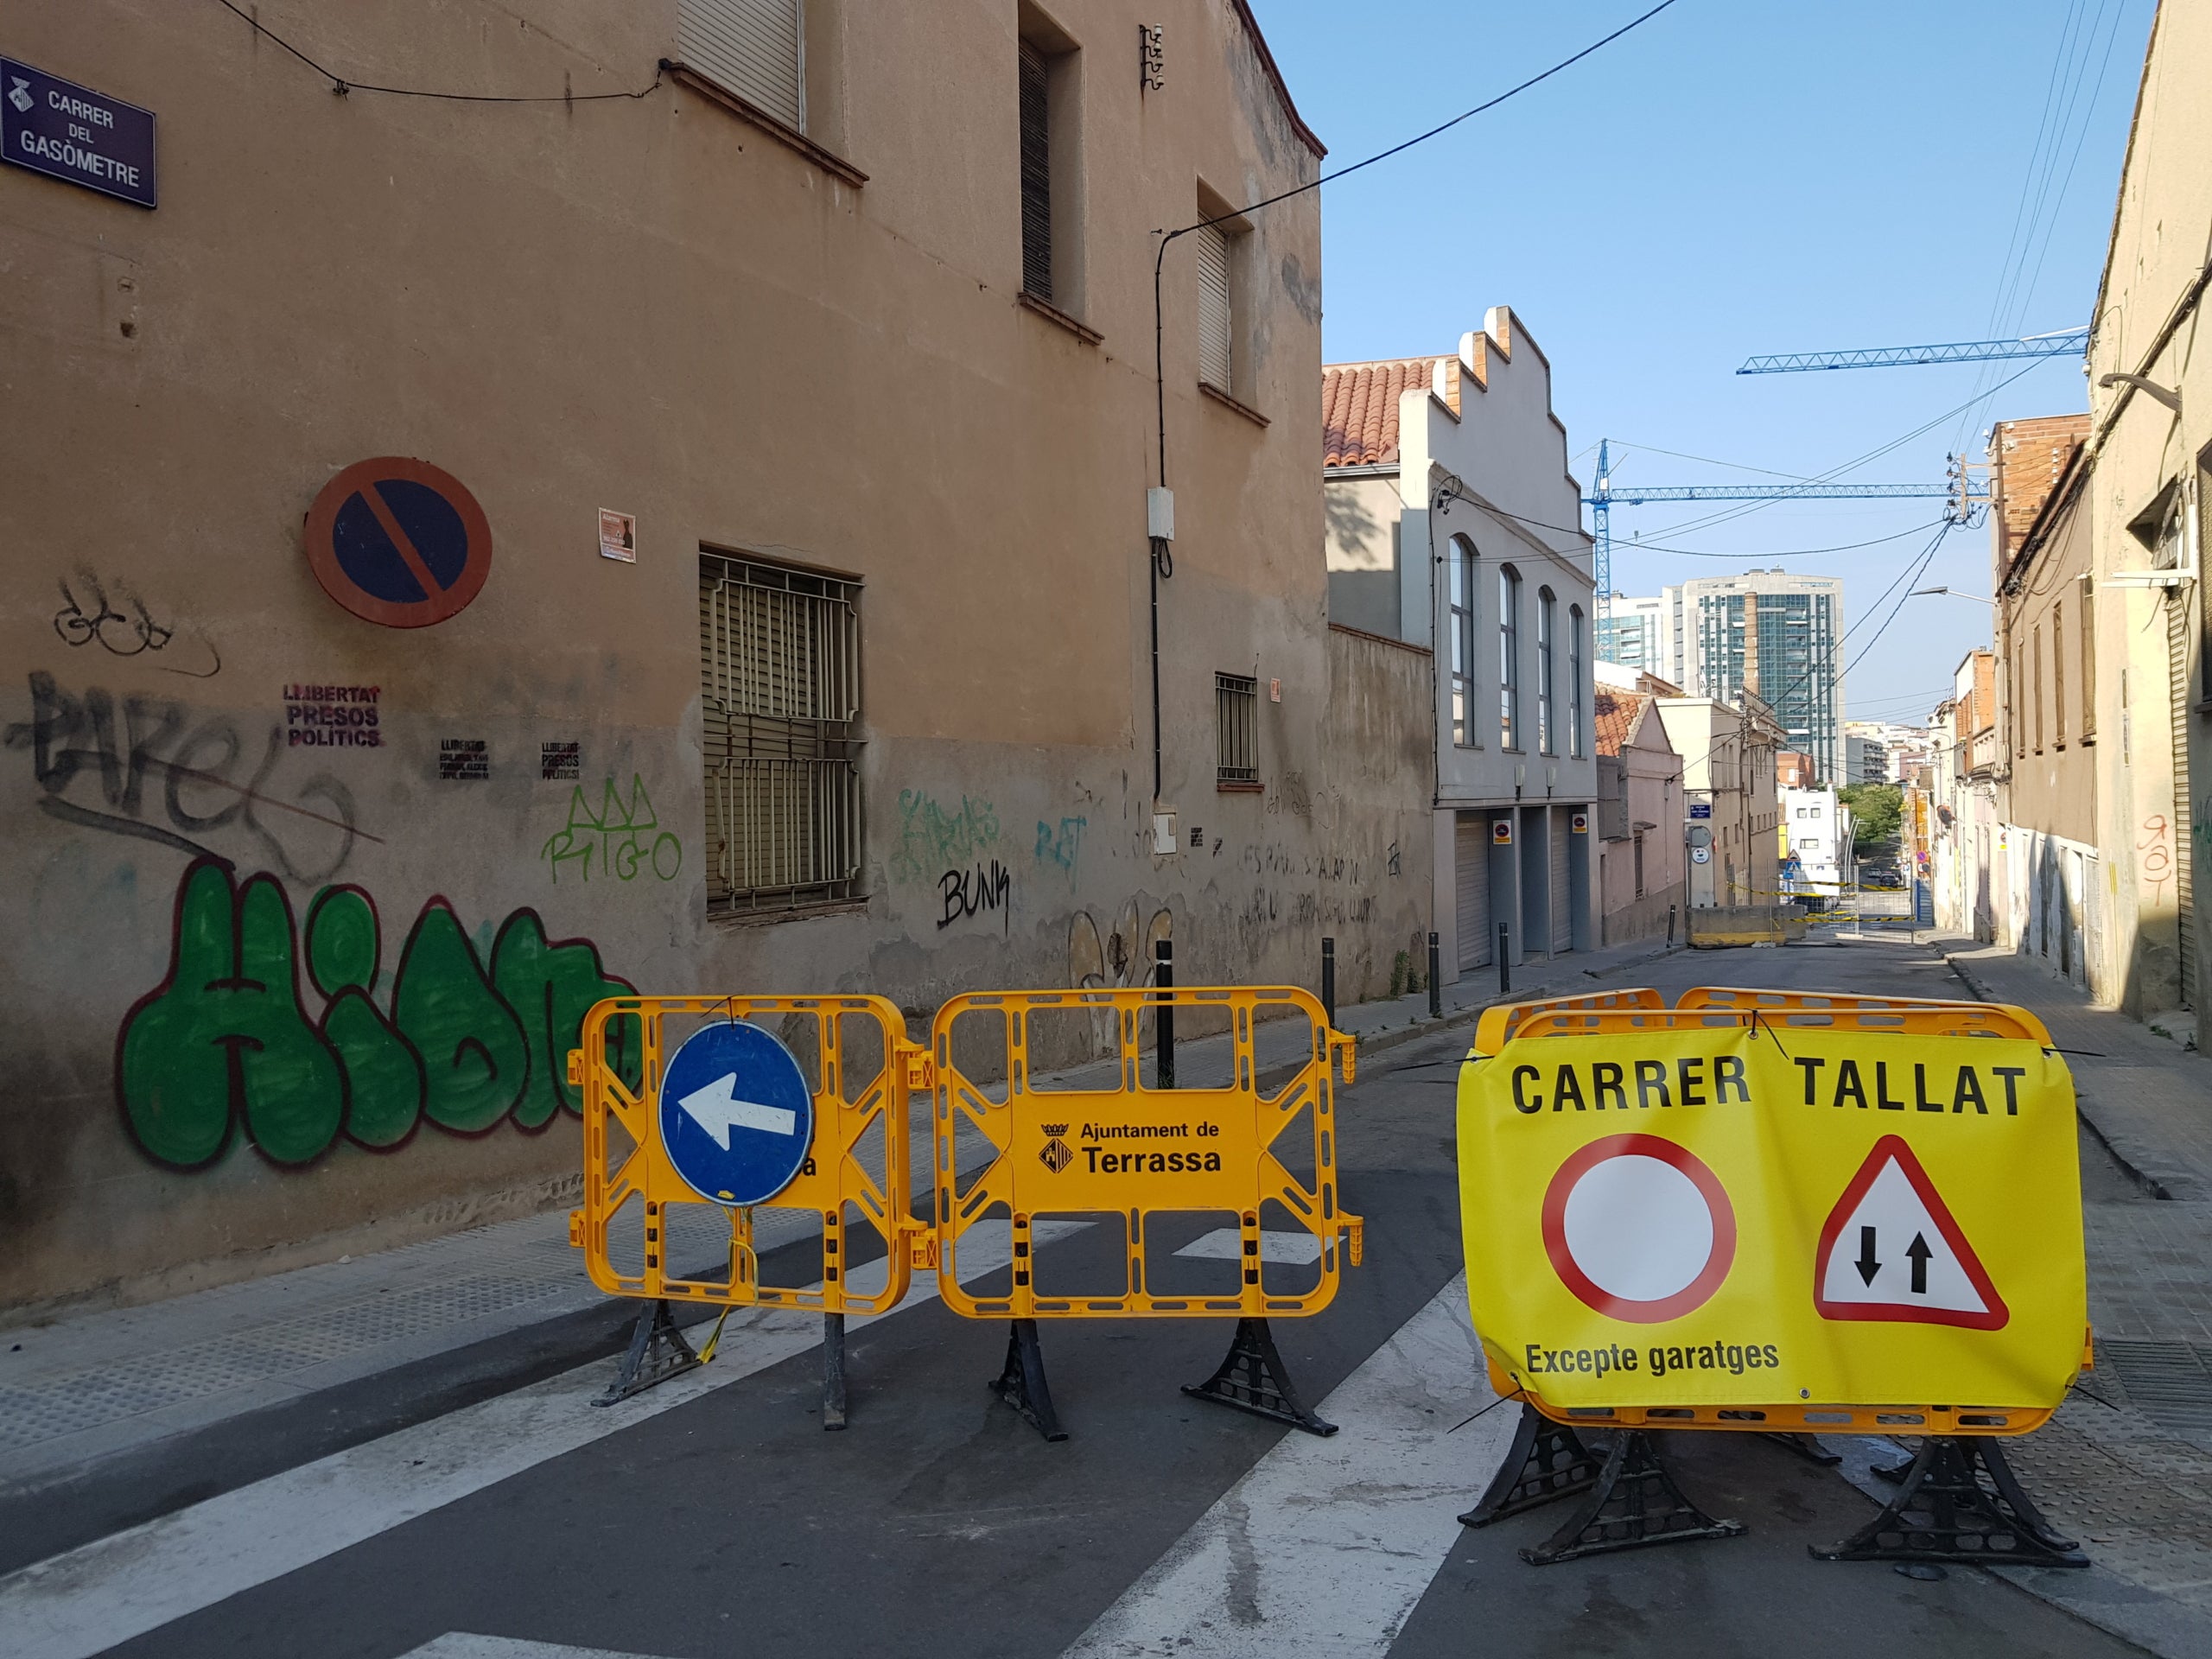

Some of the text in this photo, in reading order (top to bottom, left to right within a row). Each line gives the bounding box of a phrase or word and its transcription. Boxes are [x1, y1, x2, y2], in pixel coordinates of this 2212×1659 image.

[48, 90, 113, 129] CARRER
[68, 123, 94, 143] DEL
[21, 130, 139, 188] GASÒMETRE
[283, 684, 381, 703] LLIBERTAT
[288, 705, 378, 727] PRESOS
[542, 753, 580, 767] PRESOS
[1511, 1055, 2026, 1116] CARRER TALLAT
[1080, 1121, 1220, 1142] Ajuntament de
[1081, 1146, 1222, 1174] Terrassa
[1525, 1340, 1780, 1379] Excepte garatges
